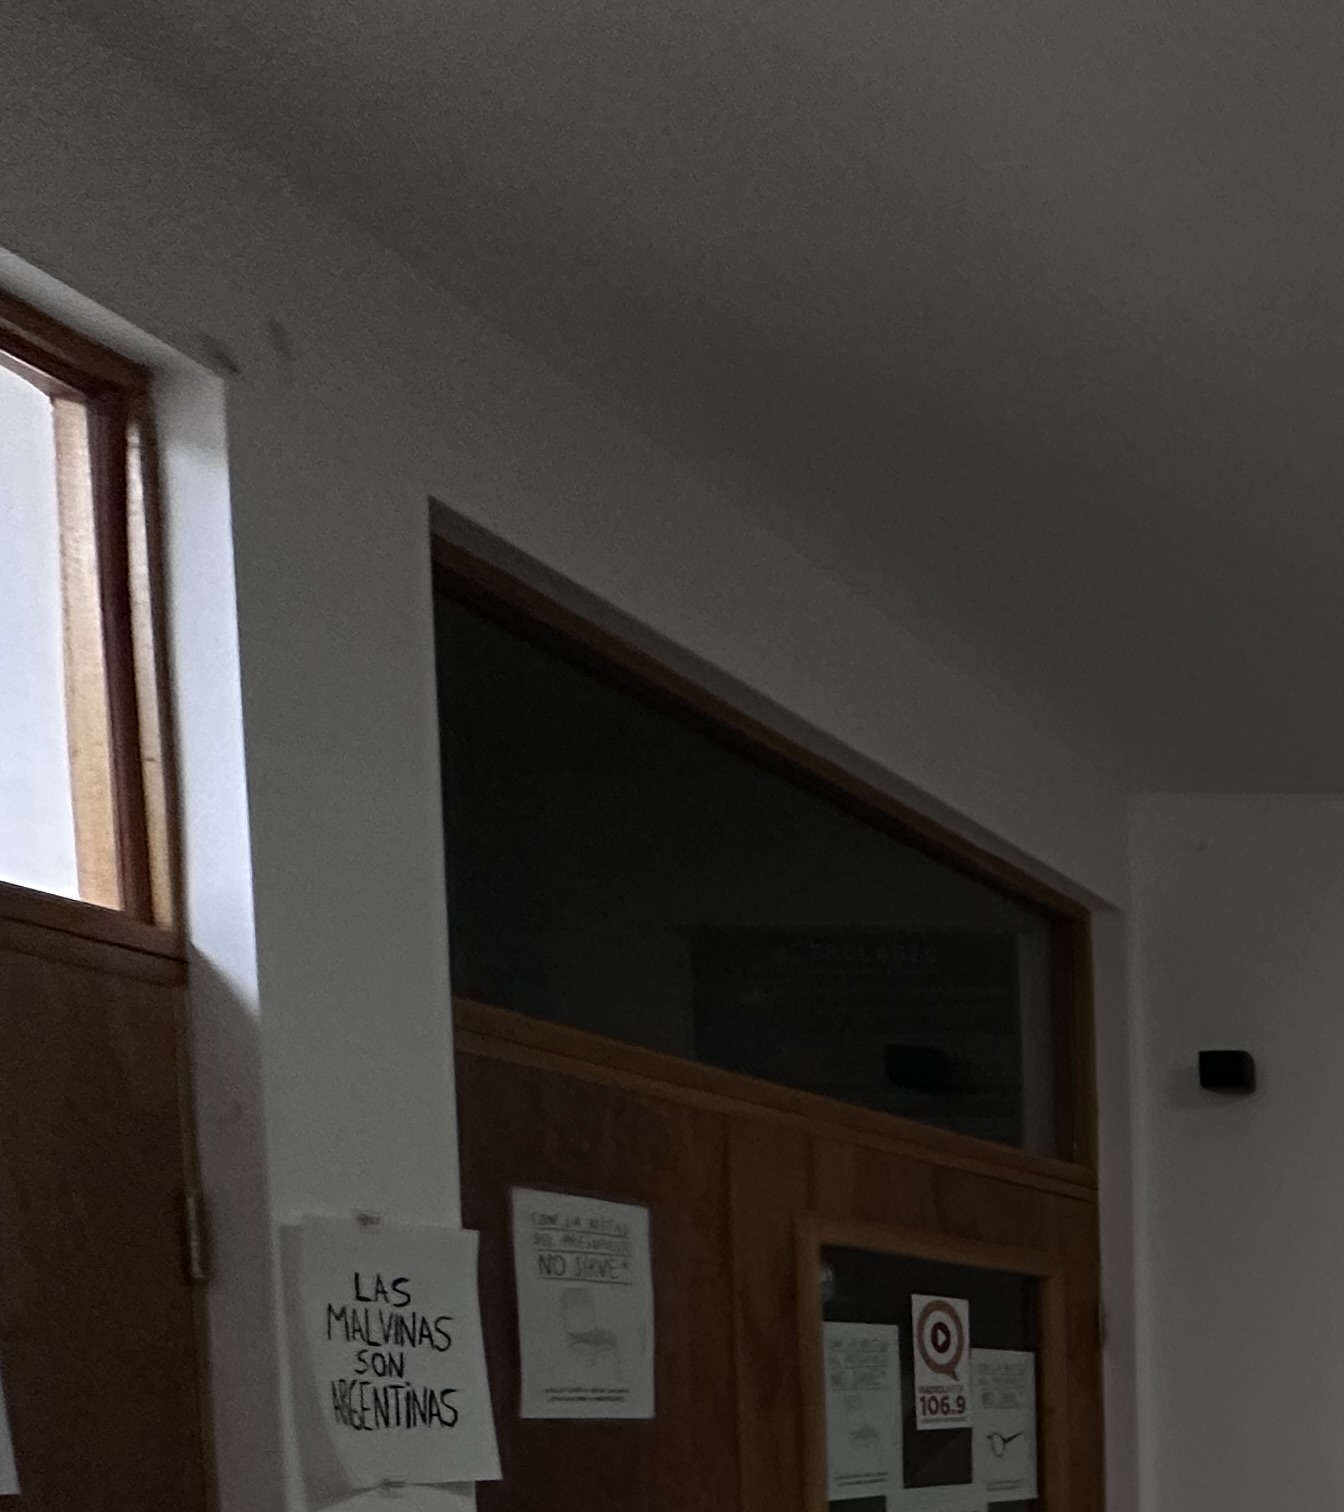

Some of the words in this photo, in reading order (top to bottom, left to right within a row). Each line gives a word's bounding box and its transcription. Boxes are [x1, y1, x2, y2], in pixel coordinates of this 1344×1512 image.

[538, 1254, 567, 1277] NO
[354, 1271, 412, 1308] LAS
[326, 1302, 455, 1352] MALVINAS
[353, 1348, 405, 1379] SON
[330, 1378, 460, 1431] ARGENTINAS
[919, 1395, 967, 1417] 106.9
